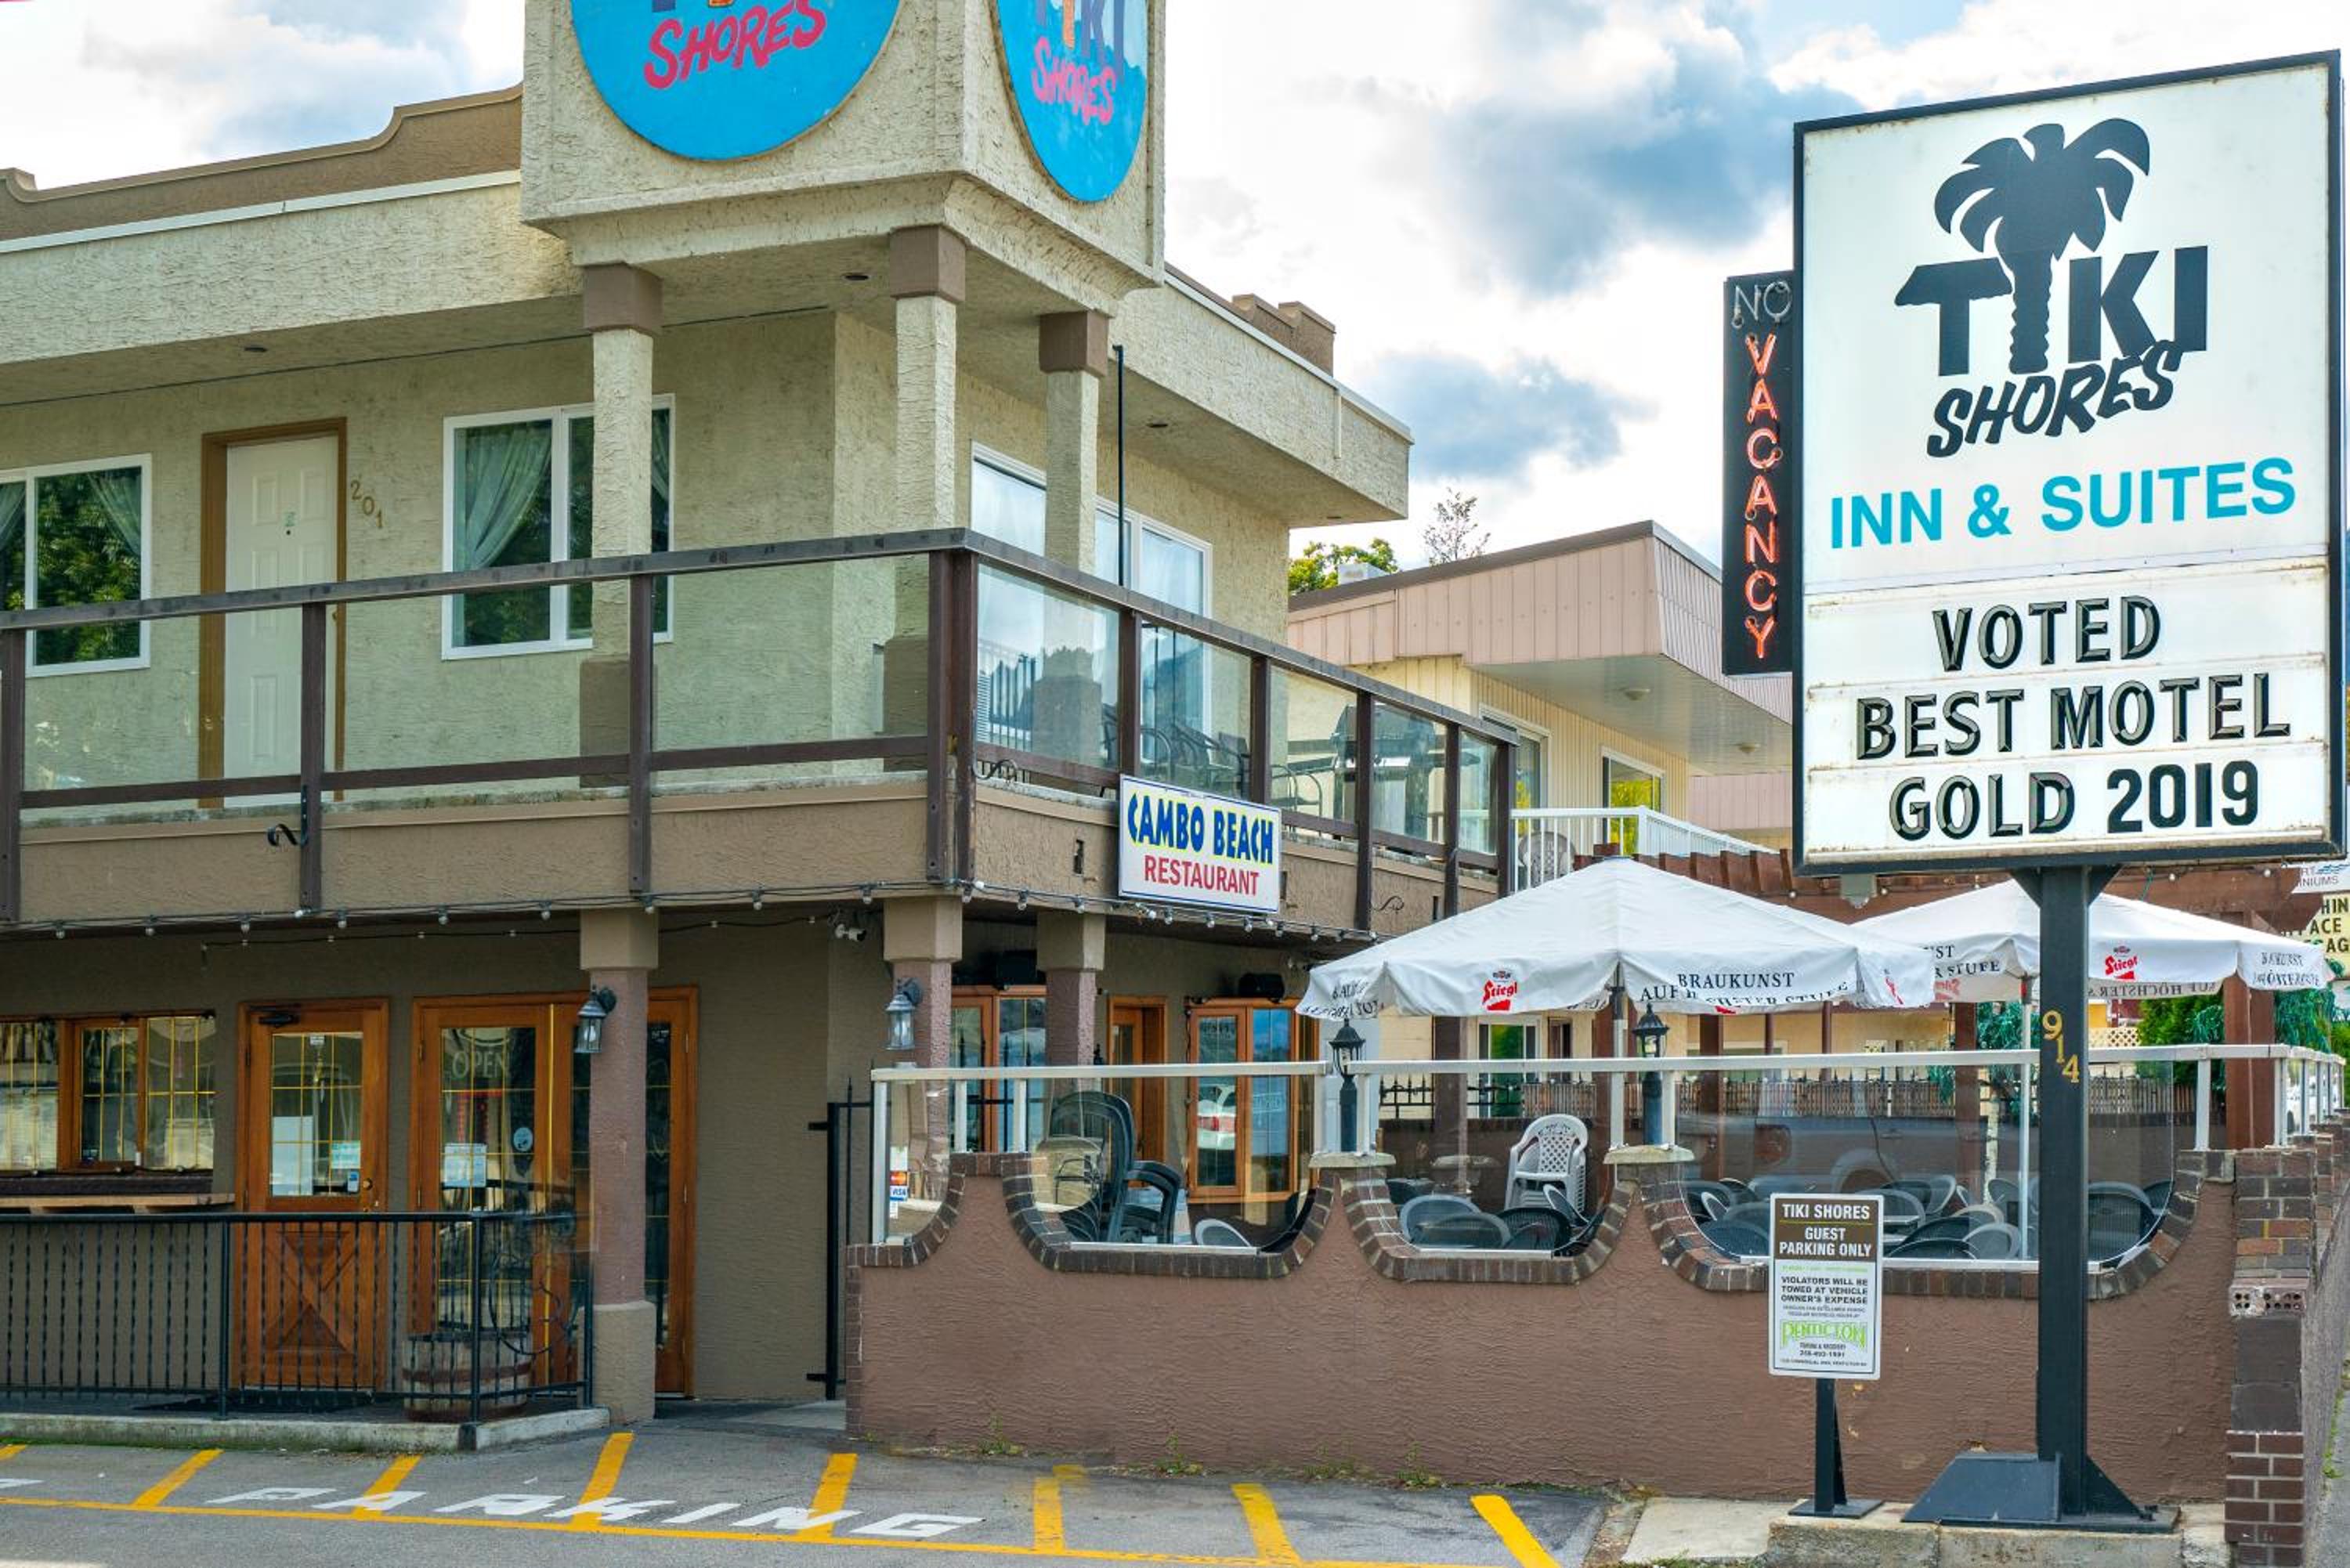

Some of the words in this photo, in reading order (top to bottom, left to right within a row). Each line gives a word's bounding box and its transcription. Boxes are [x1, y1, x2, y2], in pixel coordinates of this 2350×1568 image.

[644, 0, 826, 89] SHORES
[1032, 35, 1118, 125] SHORES
[1731, 280, 1792, 323] NO
[1894, 244, 2208, 377] TIKI
[1926, 339, 2182, 457] SHORES
[350, 479, 385, 529] 201
[1744, 332, 1779, 659] VACANCY
[1831, 489, 1943, 550] INN
[1968, 483, 2012, 538] &
[2041, 457, 2297, 532] SUITES
[1932, 594, 2161, 672] VOTED
[1856, 688, 2025, 761] BEST
[2050, 673, 2291, 751] MOTEL
[1889, 771, 2076, 840] GOLD
[2106, 761, 2259, 834] 2019
[1127, 793, 1206, 853] CAMBO
[1213, 810, 1274, 865] BEACH
[1144, 854, 1259, 896] RESTAURANT
[1482, 980, 1518, 1005] Stiegl
[1640, 985, 1678, 1002] AUF
[1677, 972, 1795, 989] BRAUKUNST
[1947, 960, 2001, 977] STUFE
[2041, 1010, 2081, 1084] 914
[1782, 1204, 1809, 1219] TIKI
[1814, 1204, 1871, 1220] SHORES
[1805, 1227, 1846, 1241] GUEST
[1779, 1241, 1835, 1255] PARKING
[1839, 1243, 1872, 1257] ONLY
[1781, 1276, 1831, 1285] VIOLATORS
[1781, 1294, 1822, 1303] OWNER'S
[1824, 1295, 1868, 1305] EXPENSE
[1814, 1286, 1826, 1295] AT
[1829, 1287, 1868, 1295] VEHICLE
[206, 1487, 985, 1537] PARKING
